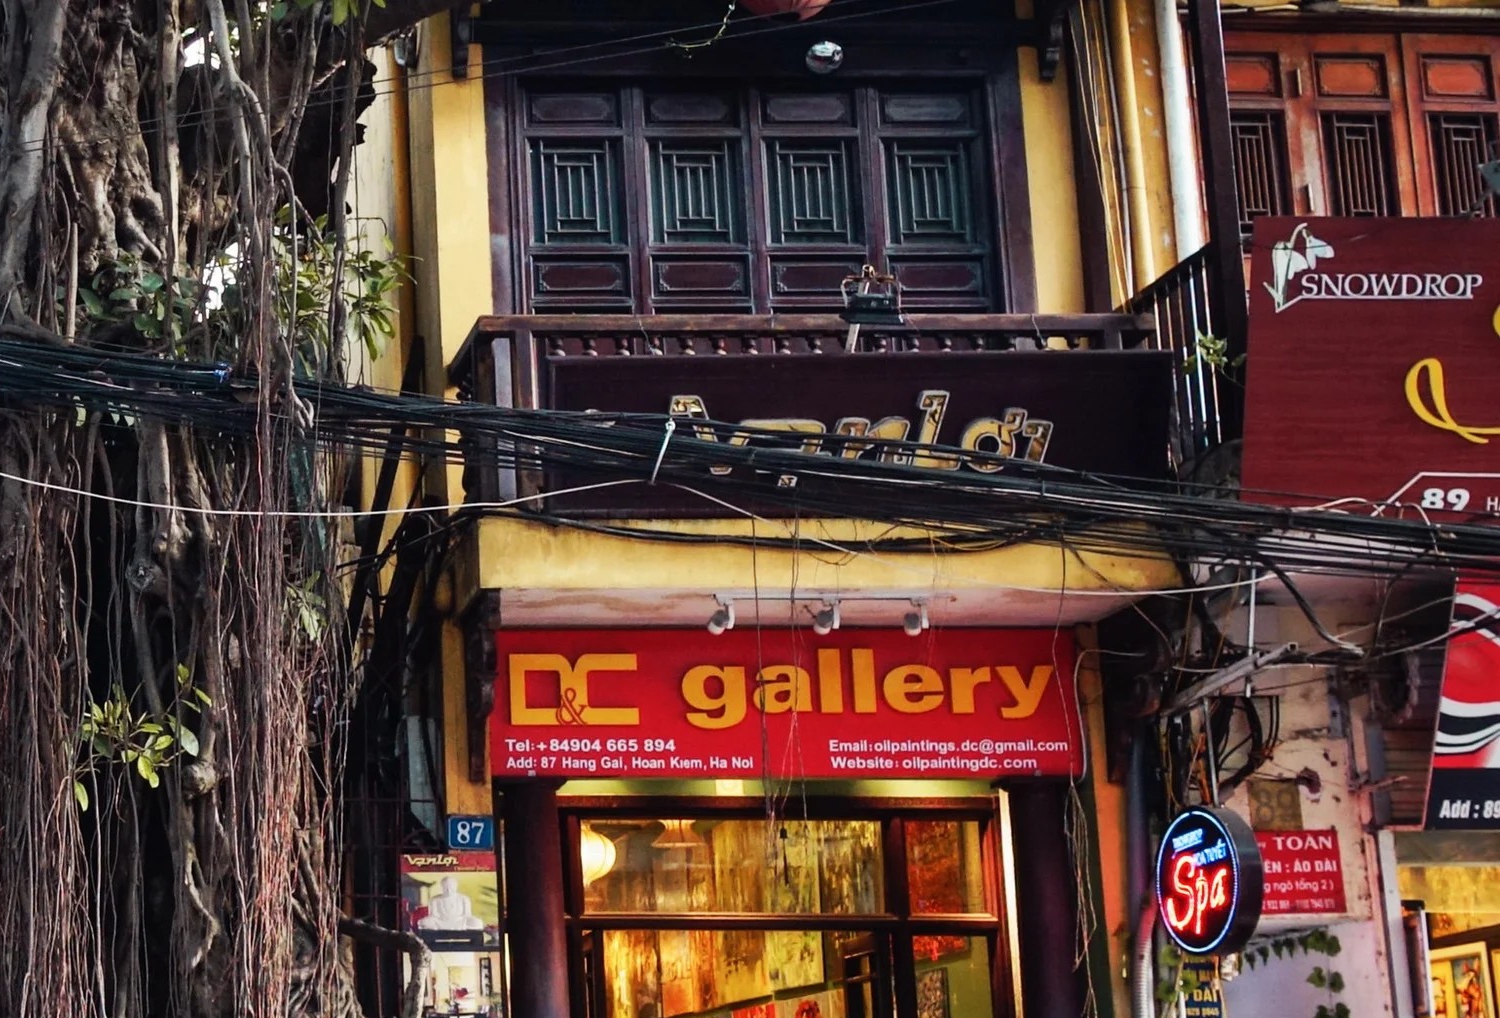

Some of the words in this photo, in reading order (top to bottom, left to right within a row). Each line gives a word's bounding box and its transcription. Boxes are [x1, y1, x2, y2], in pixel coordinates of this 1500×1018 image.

[1301, 274, 1482, 296] SNOWDROP
[1421, 488, 1470, 511] 89
[1487, 496, 1500, 511] H
[509, 653, 640, 726] D&C
[681, 648, 1054, 730] gallery
[606, 739, 638, 752] 665
[644, 739, 675, 752] 894
[506, 757, 537, 769] Add:
[541, 757, 556, 769] 87
[562, 757, 597, 771] Hang
[601, 756, 628, 770] Gai,
[632, 757, 665, 769] Hoan
[710, 757, 728, 769] Ha
[732, 757, 753, 769] Noi
[831, 757, 899, 769] Website:
[902, 757, 1037, 771] oilpaintingdc.com
[1439, 799, 1471, 819] Add
[1483, 799, 1500, 819] 89
[457, 821, 484, 844] 87
[1167, 855, 1227, 935] Spa
